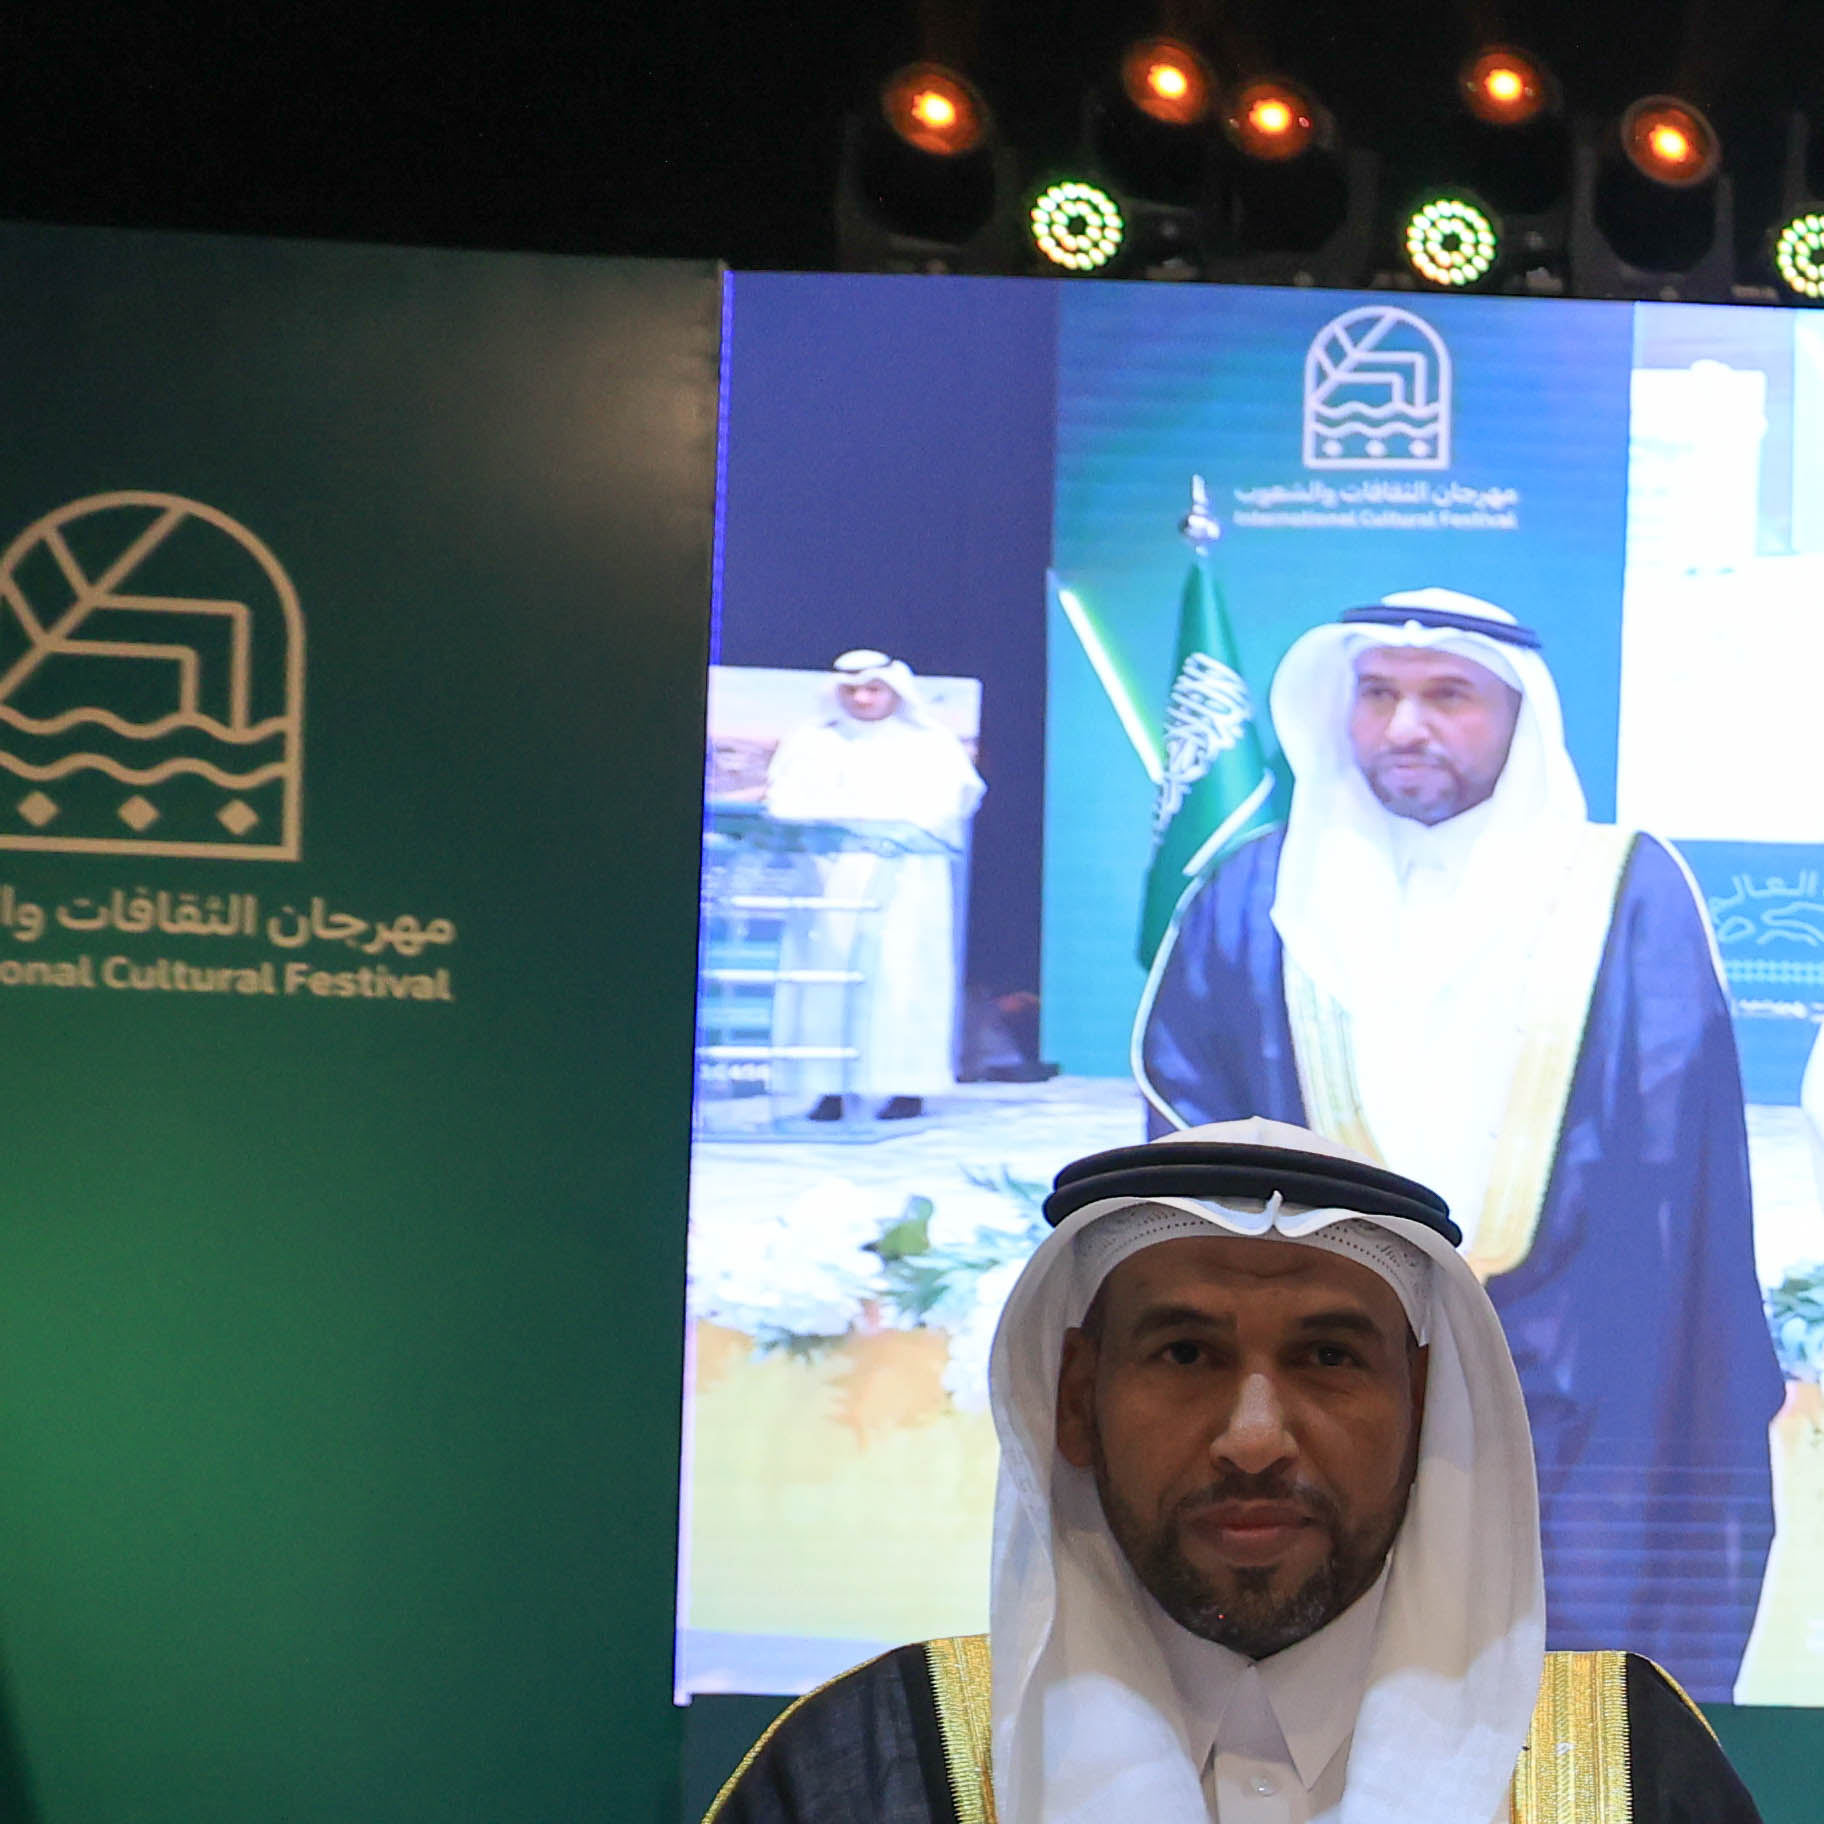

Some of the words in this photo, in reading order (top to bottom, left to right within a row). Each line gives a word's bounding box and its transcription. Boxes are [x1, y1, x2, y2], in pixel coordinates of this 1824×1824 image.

[56, 886, 257, 937] الثقافات
[266, 895, 457, 957] مهرجان
[102, 955, 277, 995] Cultural
[283, 962, 455, 1001] Festival
